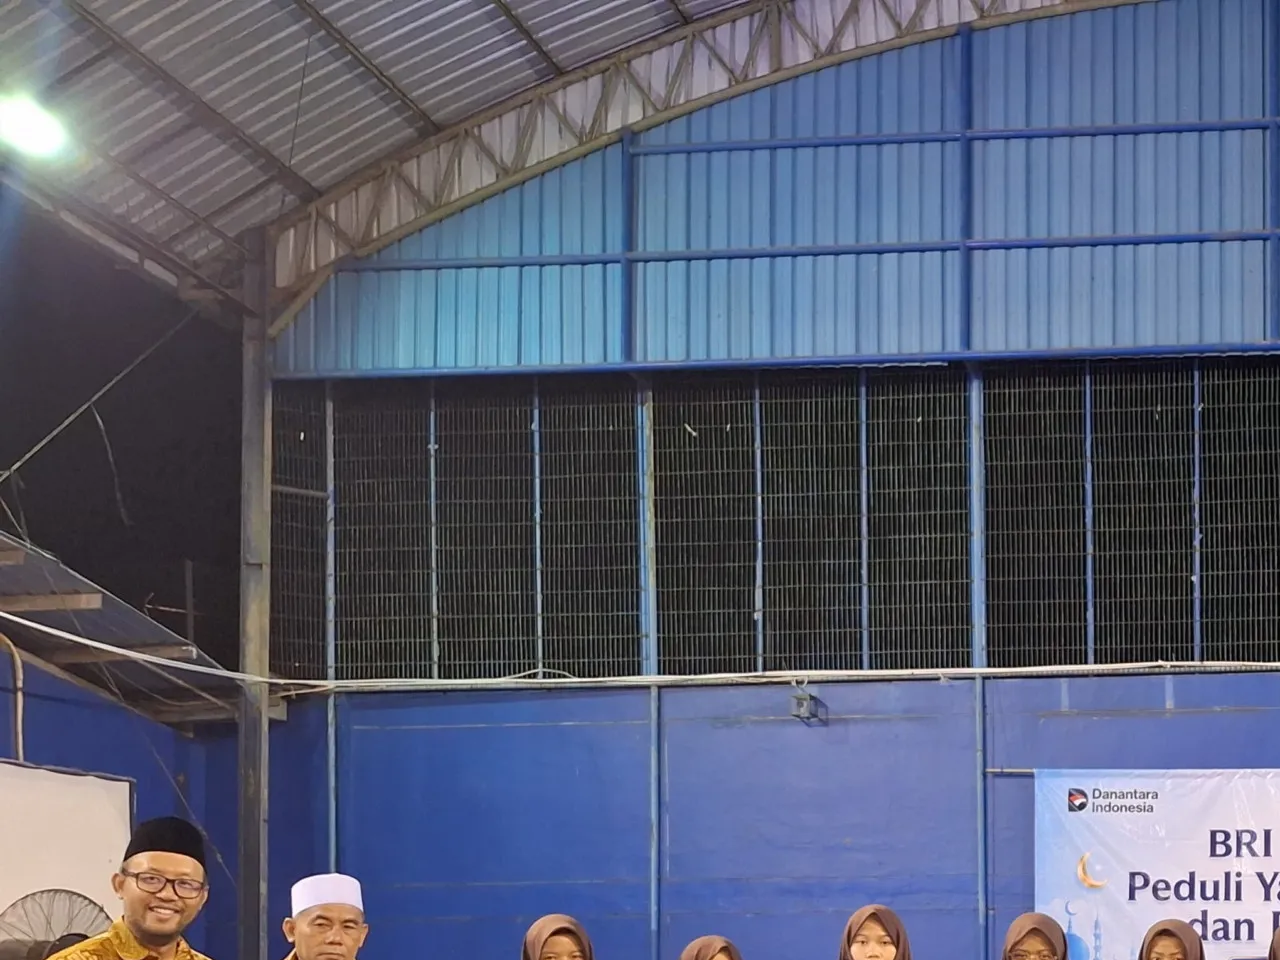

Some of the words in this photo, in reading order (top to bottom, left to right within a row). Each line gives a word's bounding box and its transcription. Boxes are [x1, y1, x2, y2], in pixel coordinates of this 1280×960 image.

[1092, 787, 1159, 800] Danantara
[1092, 801, 1154, 813] Indonesia
[1209, 829, 1272, 858] BRI
[1128, 870, 1243, 901] Peduli
[1189, 909, 1255, 941] dan
